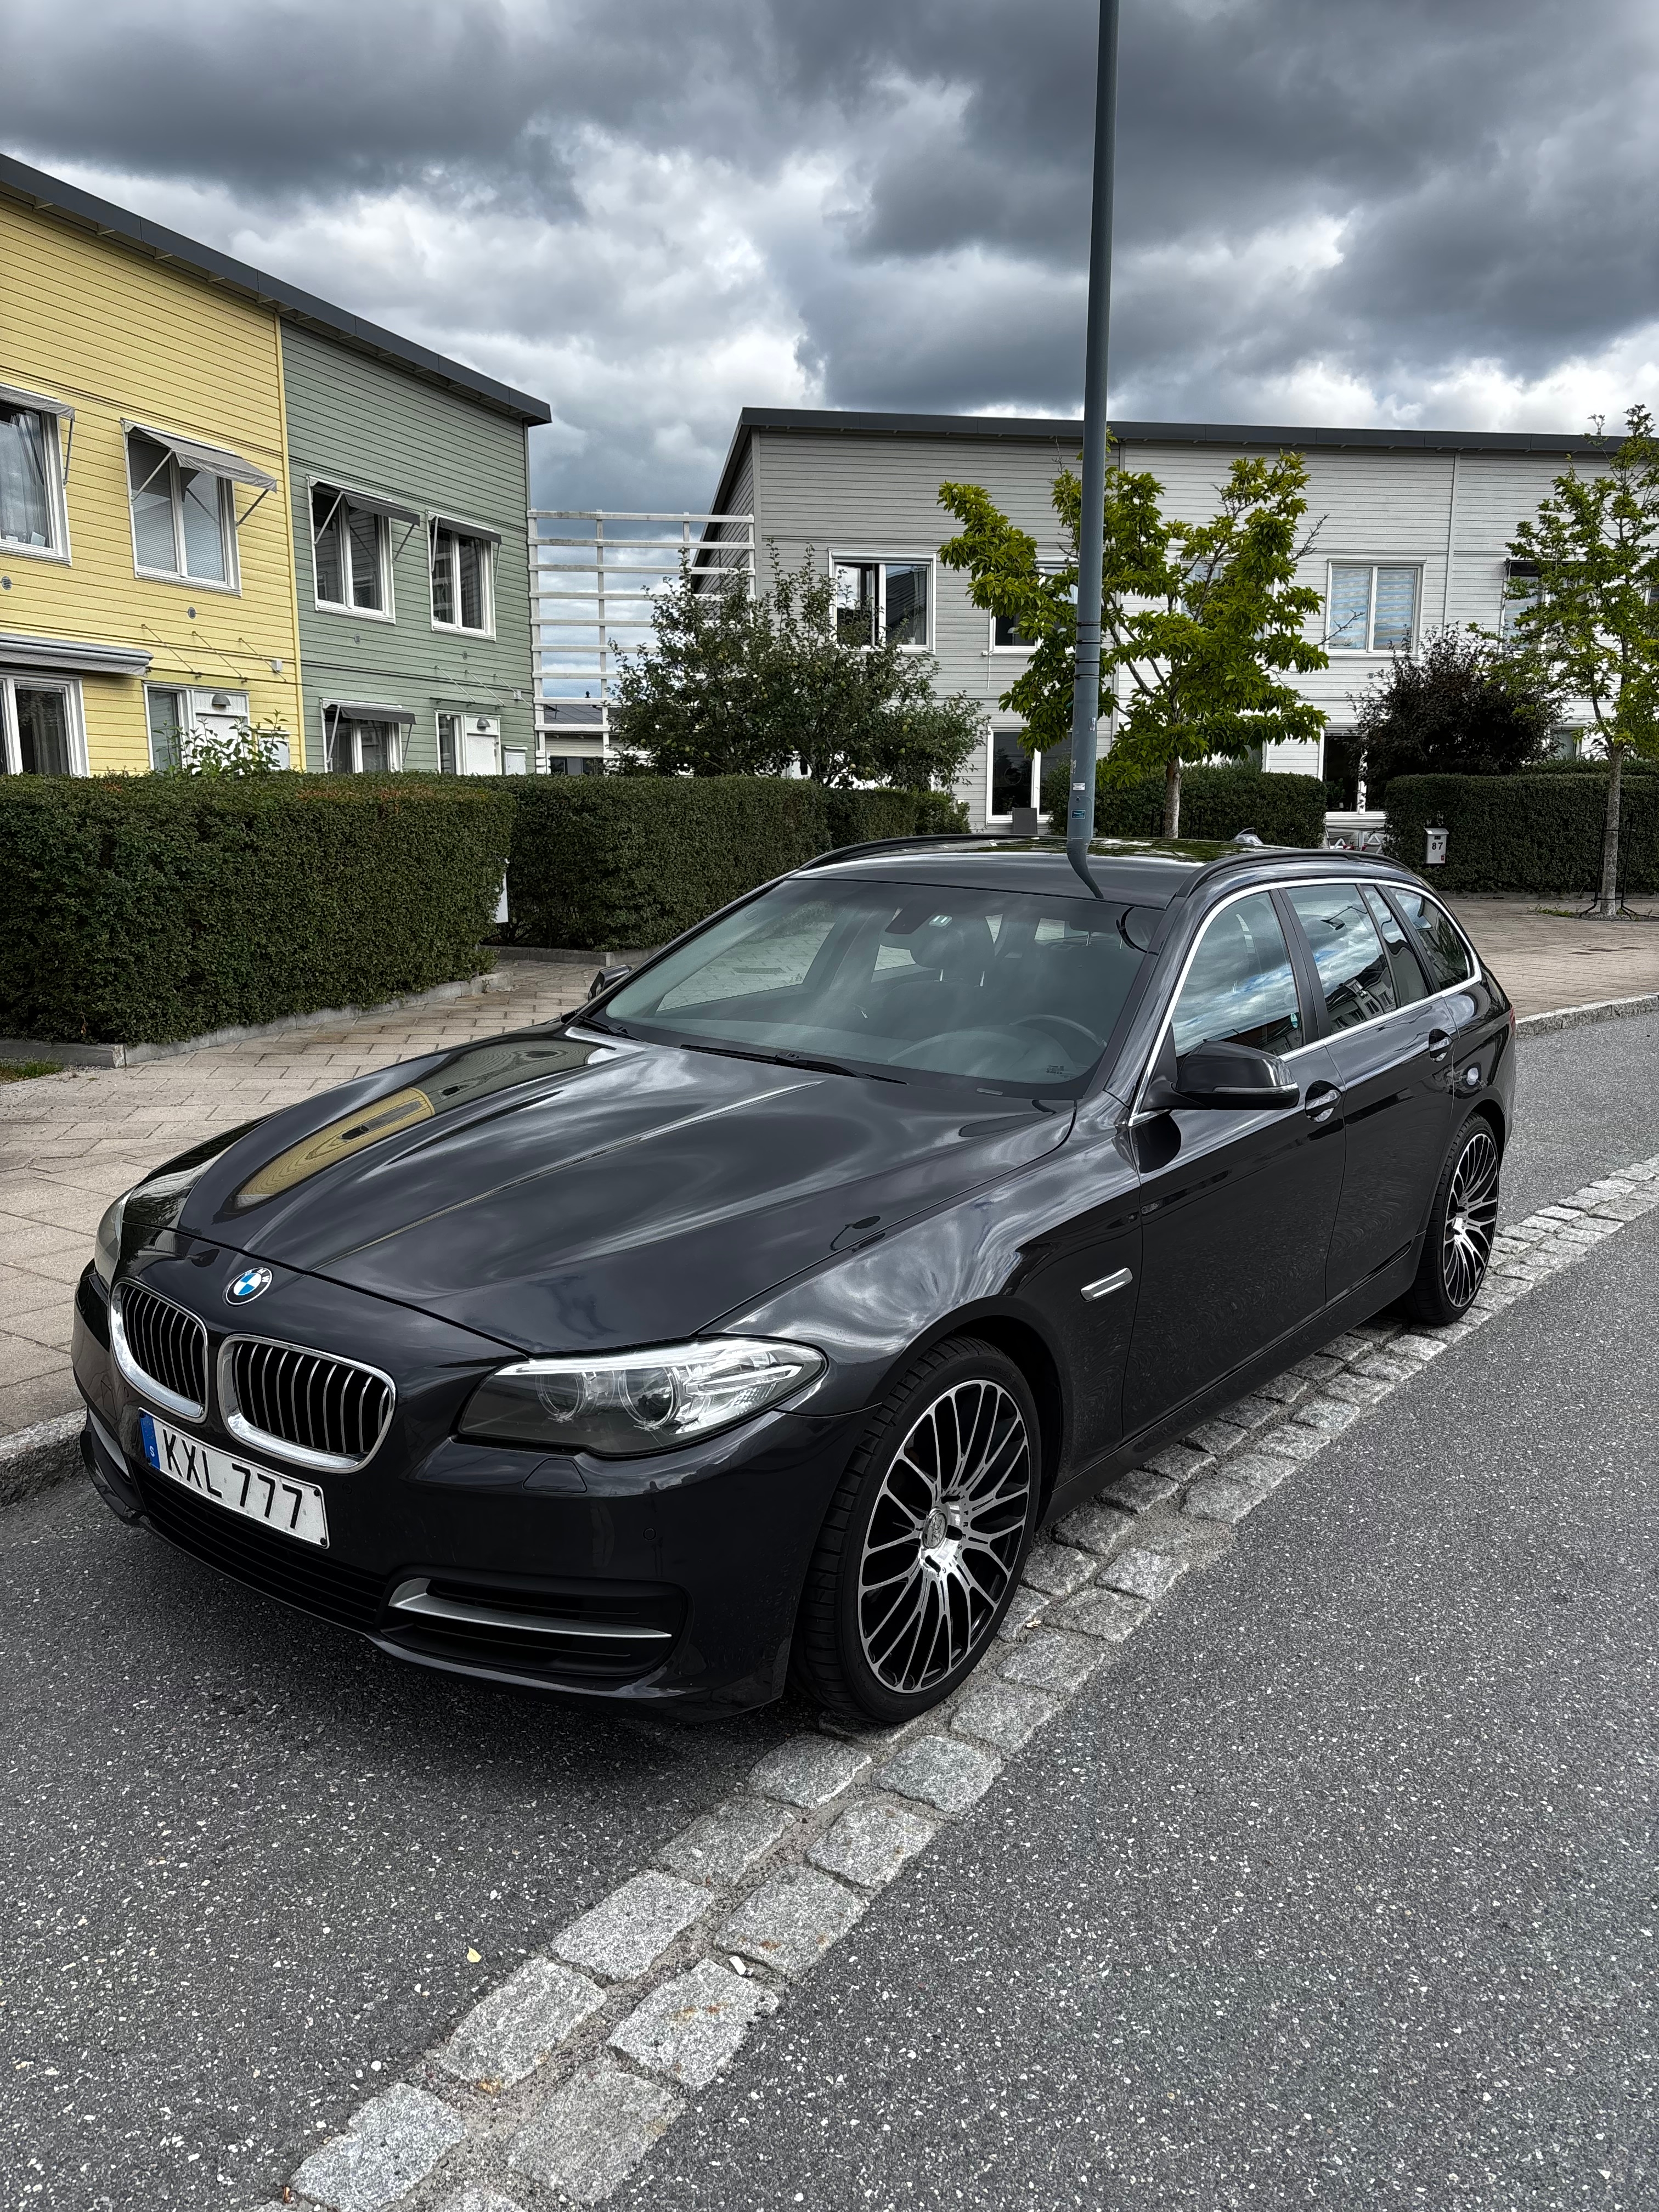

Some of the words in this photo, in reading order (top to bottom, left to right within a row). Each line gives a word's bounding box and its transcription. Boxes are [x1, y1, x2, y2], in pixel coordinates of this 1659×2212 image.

[149, 1445, 155, 1457] S
[162, 1427, 223, 1499] KXL
[231, 1461, 303, 1530] 777
